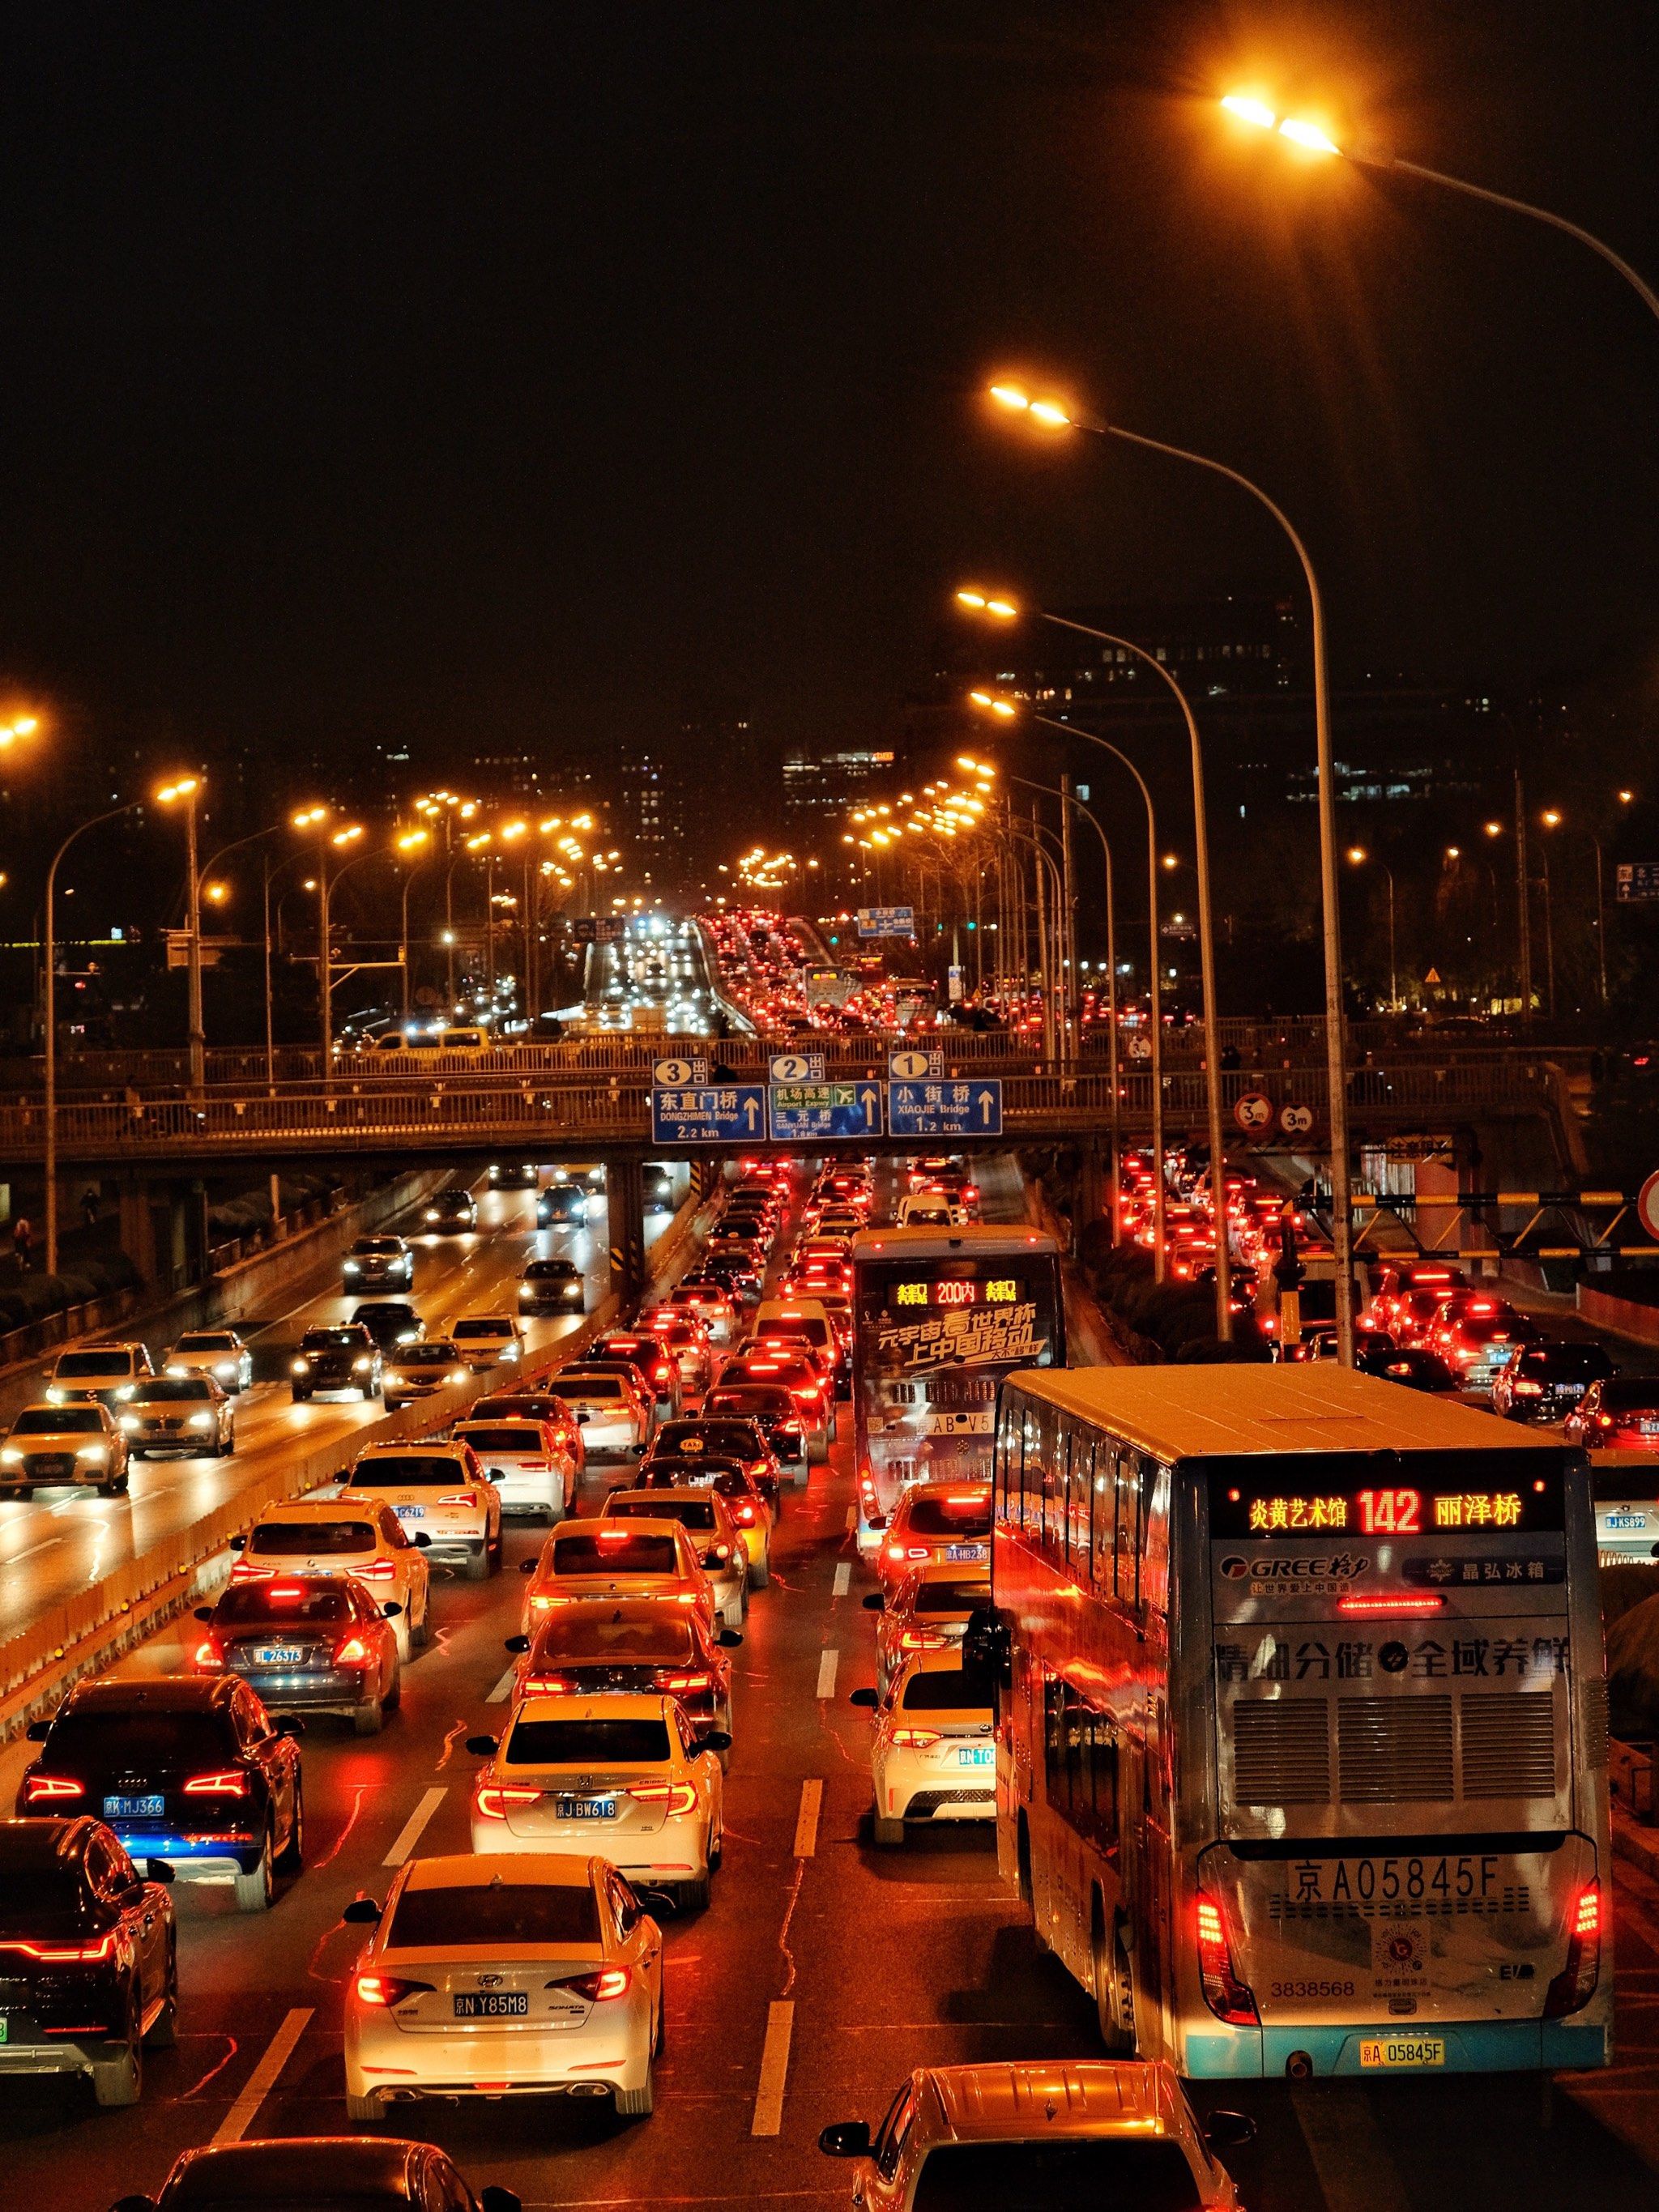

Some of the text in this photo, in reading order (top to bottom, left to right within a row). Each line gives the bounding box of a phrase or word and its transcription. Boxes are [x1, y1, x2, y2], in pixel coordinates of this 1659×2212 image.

[667, 1063, 680, 1082] 3
[693, 1060, 705, 1084] 出口
[783, 1059, 797, 1078] 2
[809, 1056, 821, 1079] 出口
[903, 1055, 913, 1075] 1
[929, 1052, 940, 1076] 出口
[659, 1091, 738, 1110] 东直门桥
[776, 1086, 830, 1102] 机场高速
[897, 1085, 970, 1103] 小街桥
[659, 1110, 739, 1122] DONGZHIMEN Bridge
[775, 1109, 833, 1123] 三元桥
[898, 1104, 970, 1115] XIAOJIE Bridge
[677, 1125, 719, 1139] 2.2 km
[916, 1116, 962, 1132] 1.2 km
[937, 1281, 975, 1304] 200内
[1250, 1496, 1348, 1530] 炎黄艺术馆
[1360, 1490, 1420, 1533] 142
[1435, 1492, 1522, 1526] 丽泽桥
[1251, 1559, 1328, 1577] GREE
[1462, 1561, 1544, 1580] 晶弘冰箱
[1252, 1582, 1350, 1594] 让世界爱上中国造
[1295, 1857, 1498, 1903] 京A05845F
[1270, 1980, 1355, 1997] 3838568
